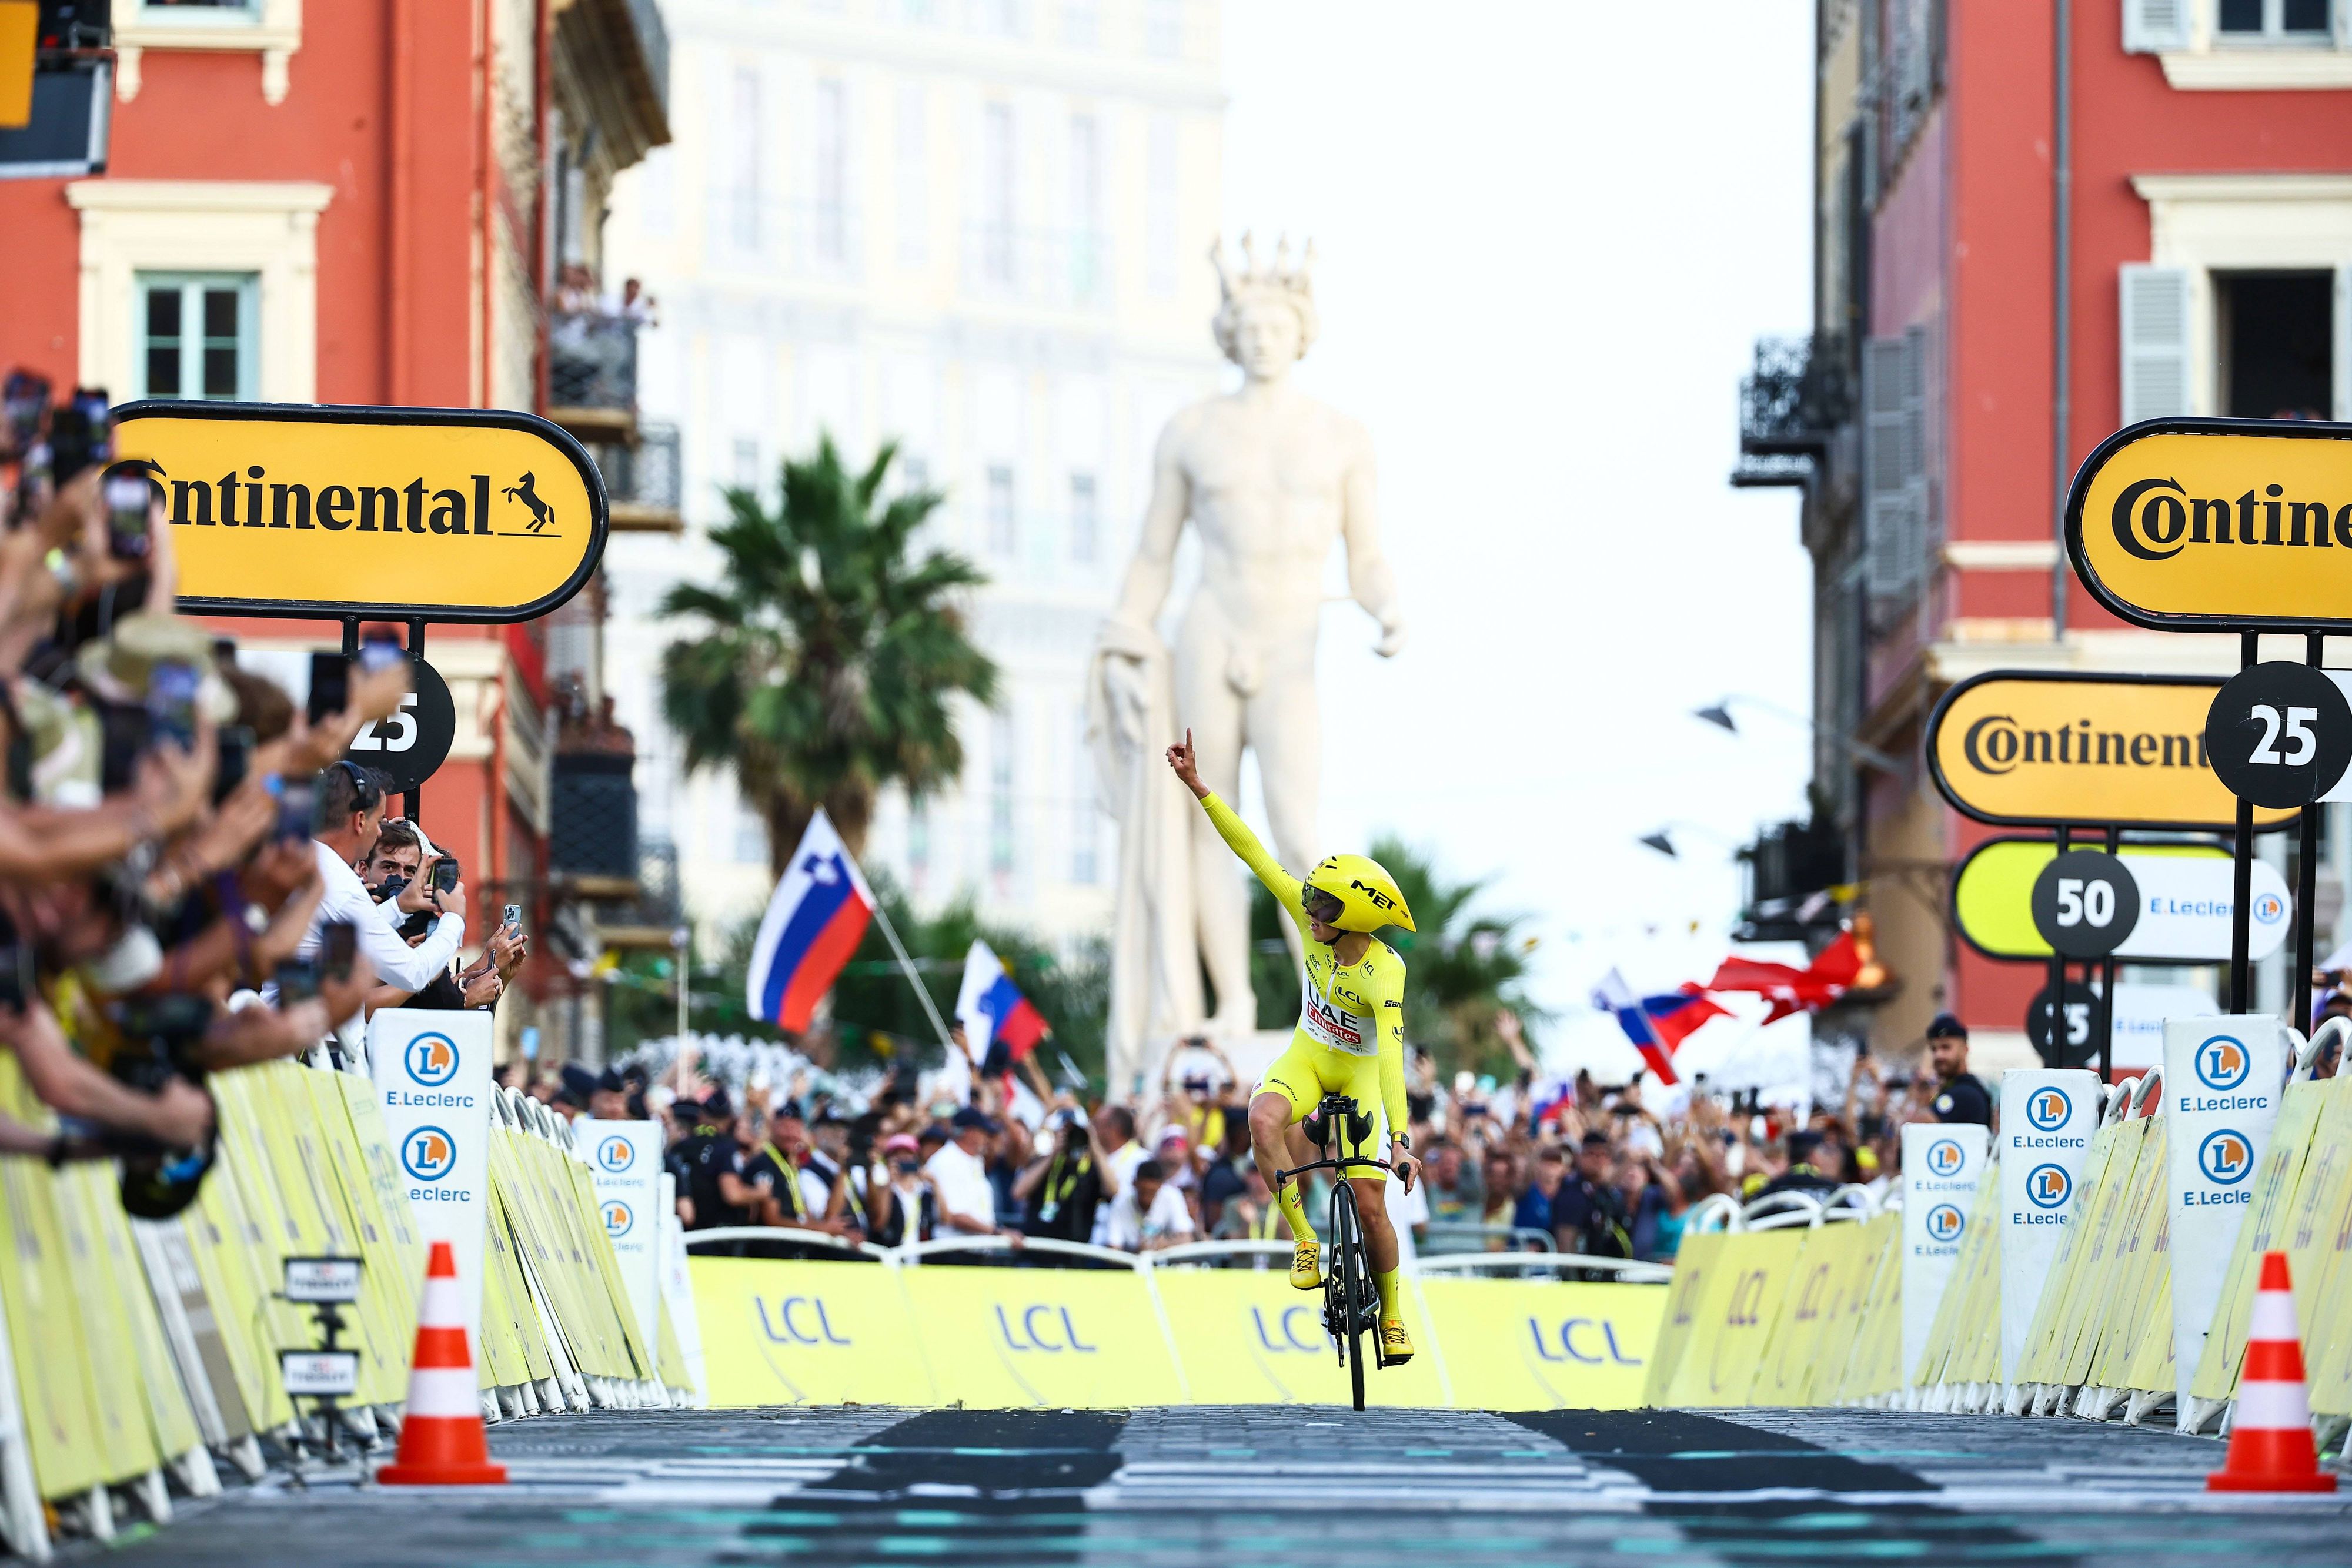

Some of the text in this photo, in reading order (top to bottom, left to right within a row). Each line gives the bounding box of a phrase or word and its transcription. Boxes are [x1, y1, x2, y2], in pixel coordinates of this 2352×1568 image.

[98, 458, 493, 536] ntinental
[2249, 705, 2317, 766] 25
[1350, 880, 1397, 910] MET
[2057, 878, 2115, 927] 50
[1364, 960, 1374, 977] LCL
[1308, 979, 1358, 1032] UAE
[1338, 986, 1365, 1005] LCL
[1308, 1002, 1359, 1044] Emirates
[386, 1091, 474, 1108] E.Leclerc
[2180, 1096, 2267, 1111] E.Leclerc
[2013, 1136, 2084, 1148] E.Leclerc
[407, 1187, 471, 1202] eclerc
[755, 1296, 852, 1345] LCL
[994, 1304, 1097, 1352] LCL
[1529, 1316, 1643, 1365] LCL
